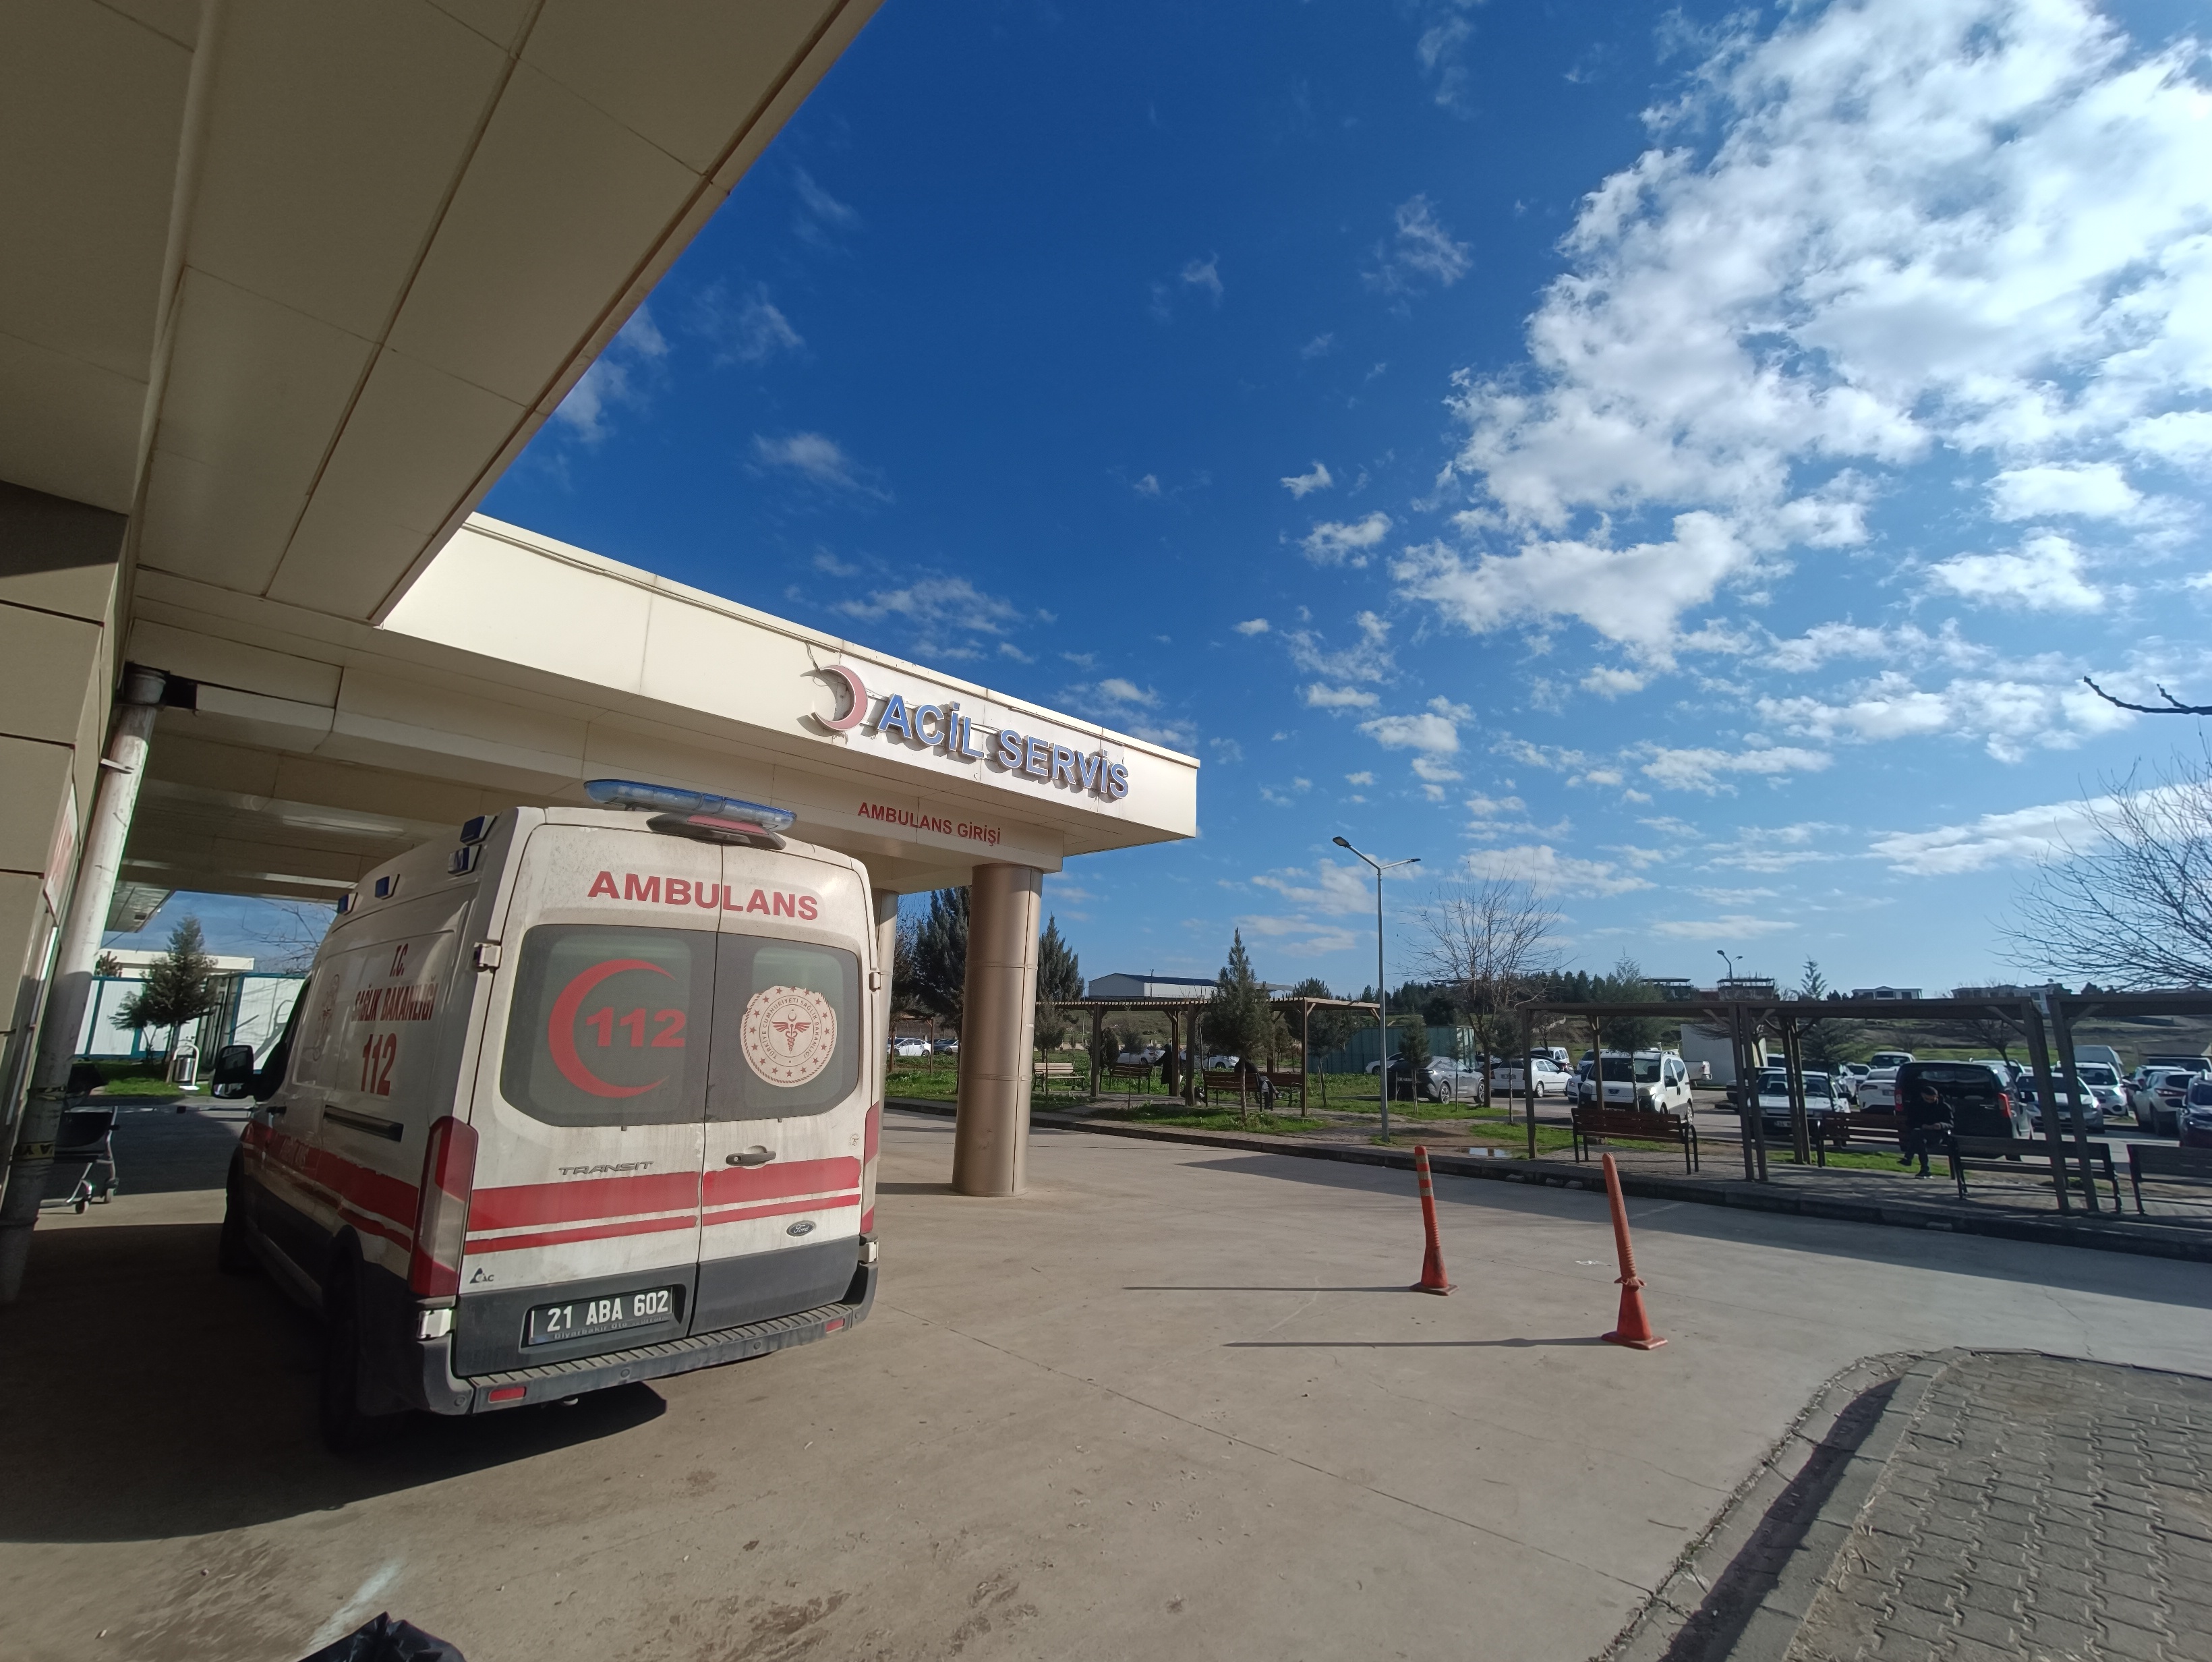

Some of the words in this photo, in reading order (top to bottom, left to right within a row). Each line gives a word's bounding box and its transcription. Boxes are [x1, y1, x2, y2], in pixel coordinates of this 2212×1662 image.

[877, 693, 985, 760] ACİL
[998, 729, 1129, 799] SERVİS
[857, 802, 952, 834] AMBULANS
[957, 821, 1001, 847] GİRİŞİ
[587, 870, 819, 921] AMBULANS
[585, 1006, 687, 1048] 112
[761, 1031, 777, 1060] TÜRKİYE
[360, 1033, 397, 1097] 112
[558, 1161, 654, 1176] TRANSIT
[547, 1305, 573, 1332] 21
[585, 1298, 622, 1325] ABA
[633, 1290, 668, 1317] 602
